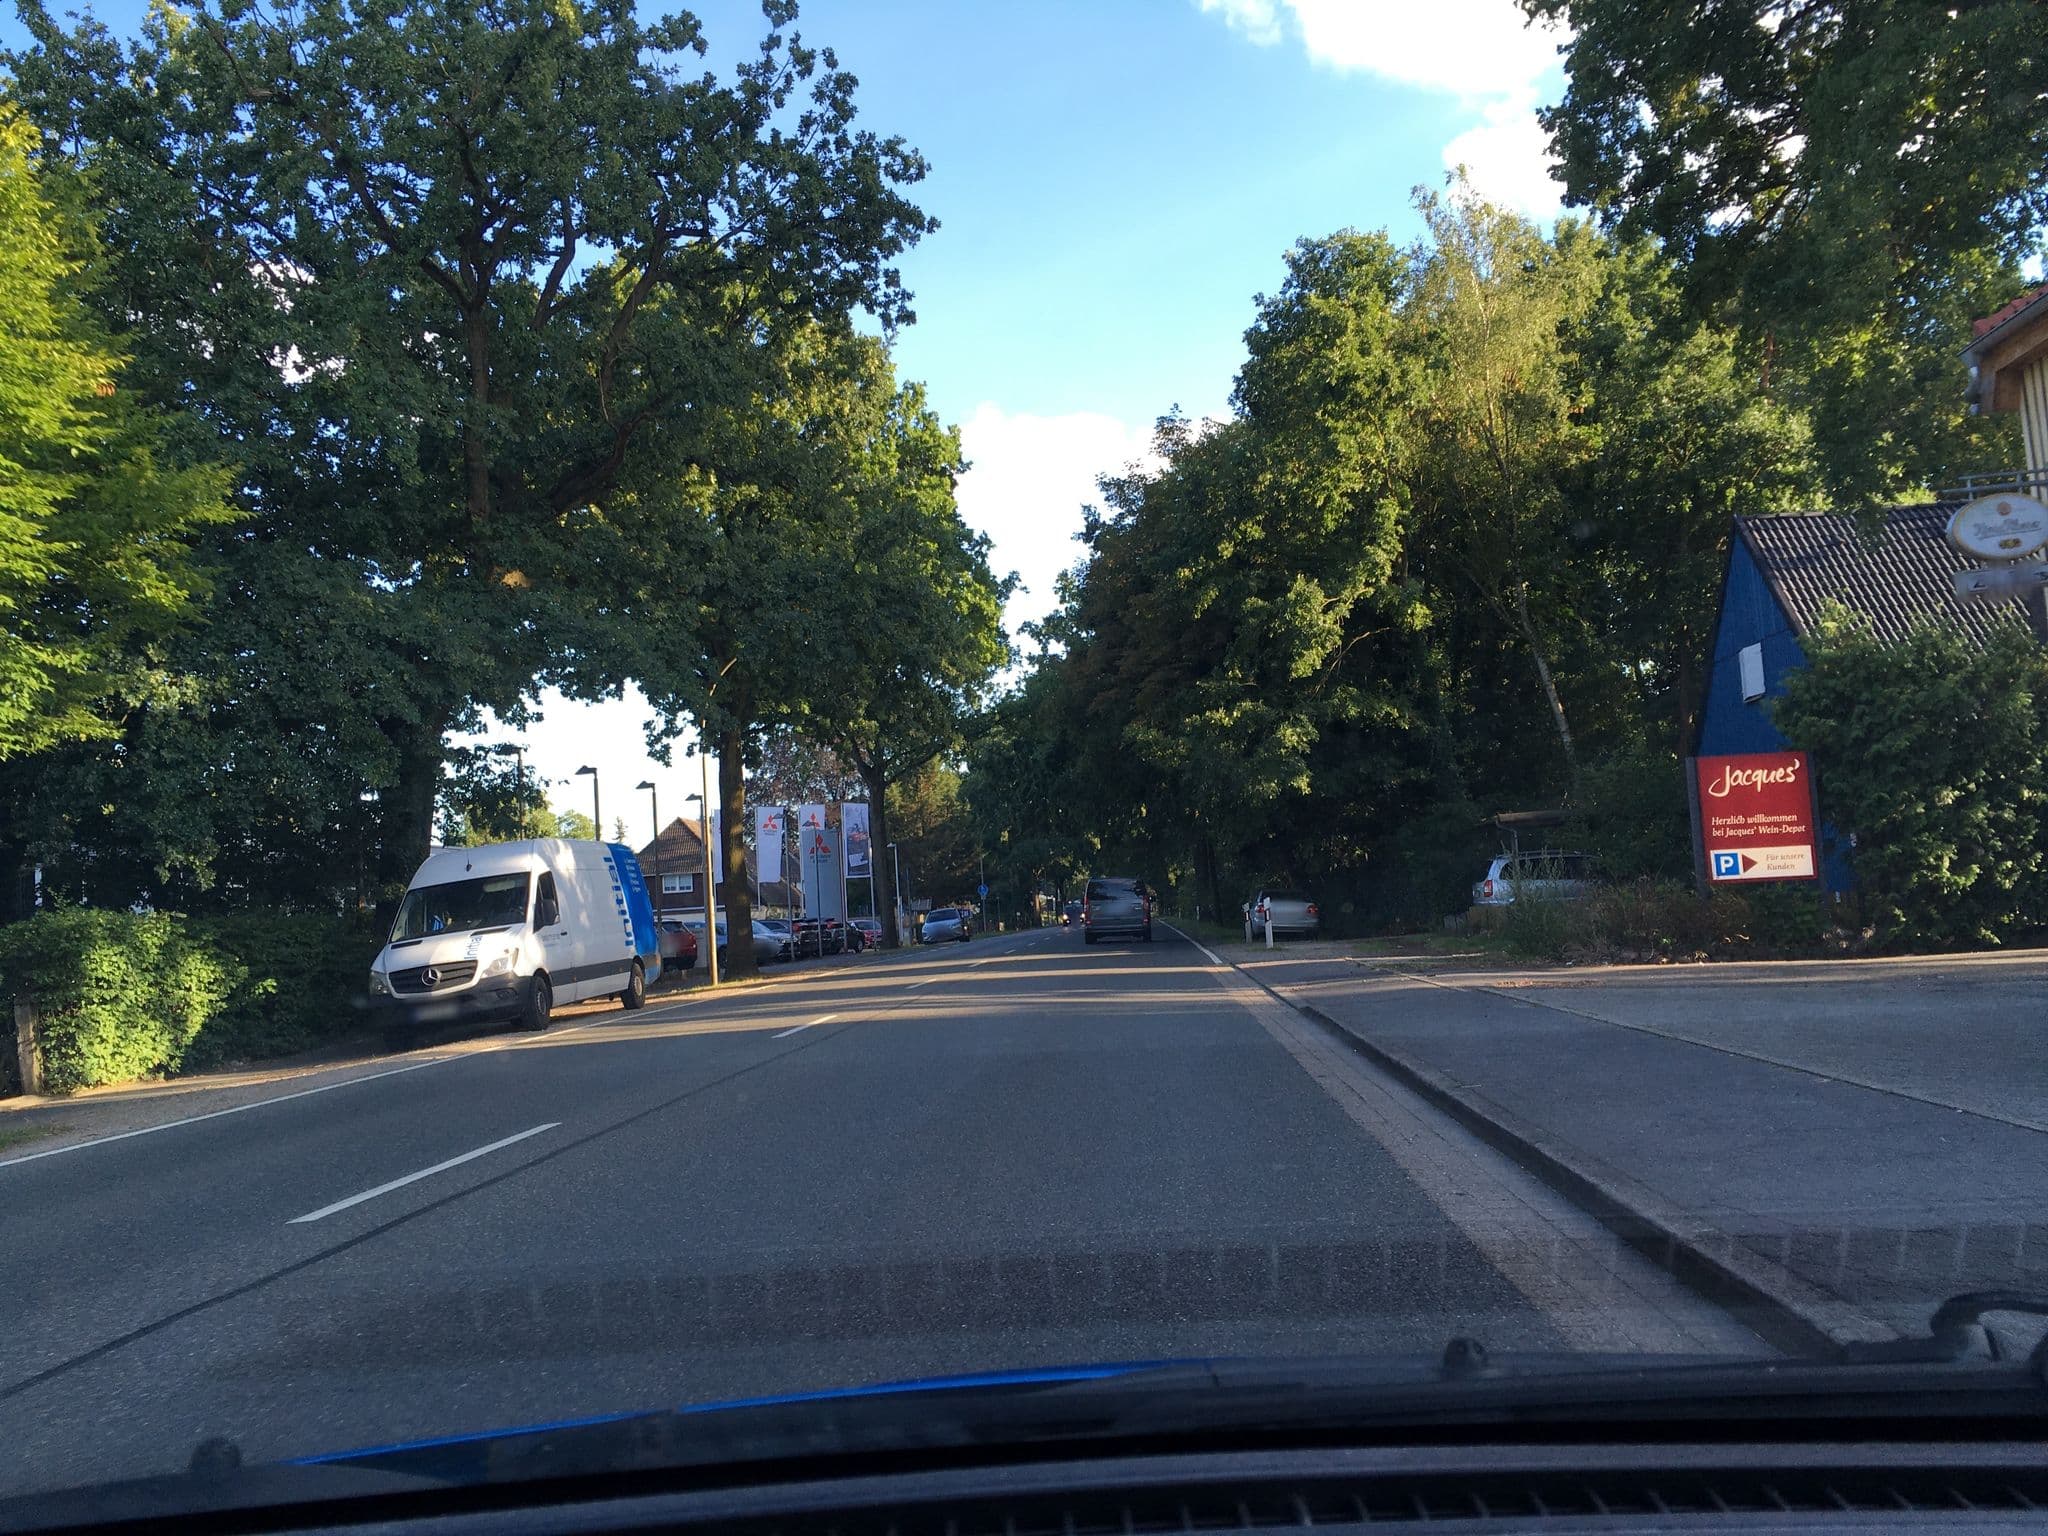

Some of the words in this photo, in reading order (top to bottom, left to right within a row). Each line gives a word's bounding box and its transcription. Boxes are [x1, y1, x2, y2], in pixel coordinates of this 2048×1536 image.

[1712, 815, 1745, 825] Herzlich
[1747, 813, 1797, 824] willkommen
[1712, 827, 1724, 836] bei
[1758, 824, 1806, 834] Wein-Depot
[1720, 856, 1734, 873] P
[1767, 863, 1795, 871] Kunden
